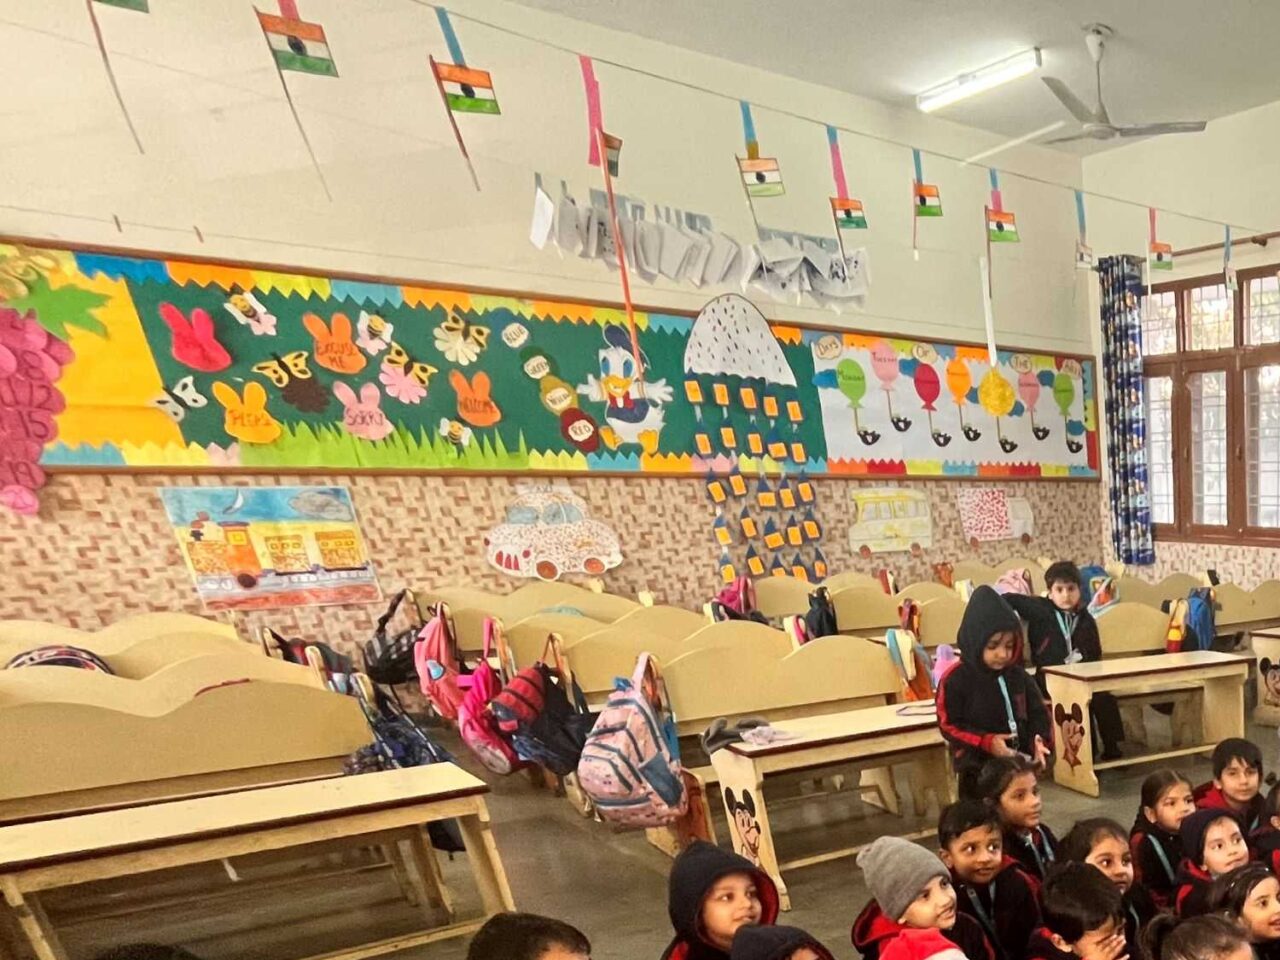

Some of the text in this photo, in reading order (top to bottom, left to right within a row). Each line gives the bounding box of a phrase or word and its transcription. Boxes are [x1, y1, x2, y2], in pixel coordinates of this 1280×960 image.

[504, 325, 526, 344] BLUE
[328, 354, 347, 368] ME
[28, 381, 53, 412] 12
[18, 409, 49, 439] 15
[346, 407, 384, 426] SORRY
[571, 424, 592, 436] RED
